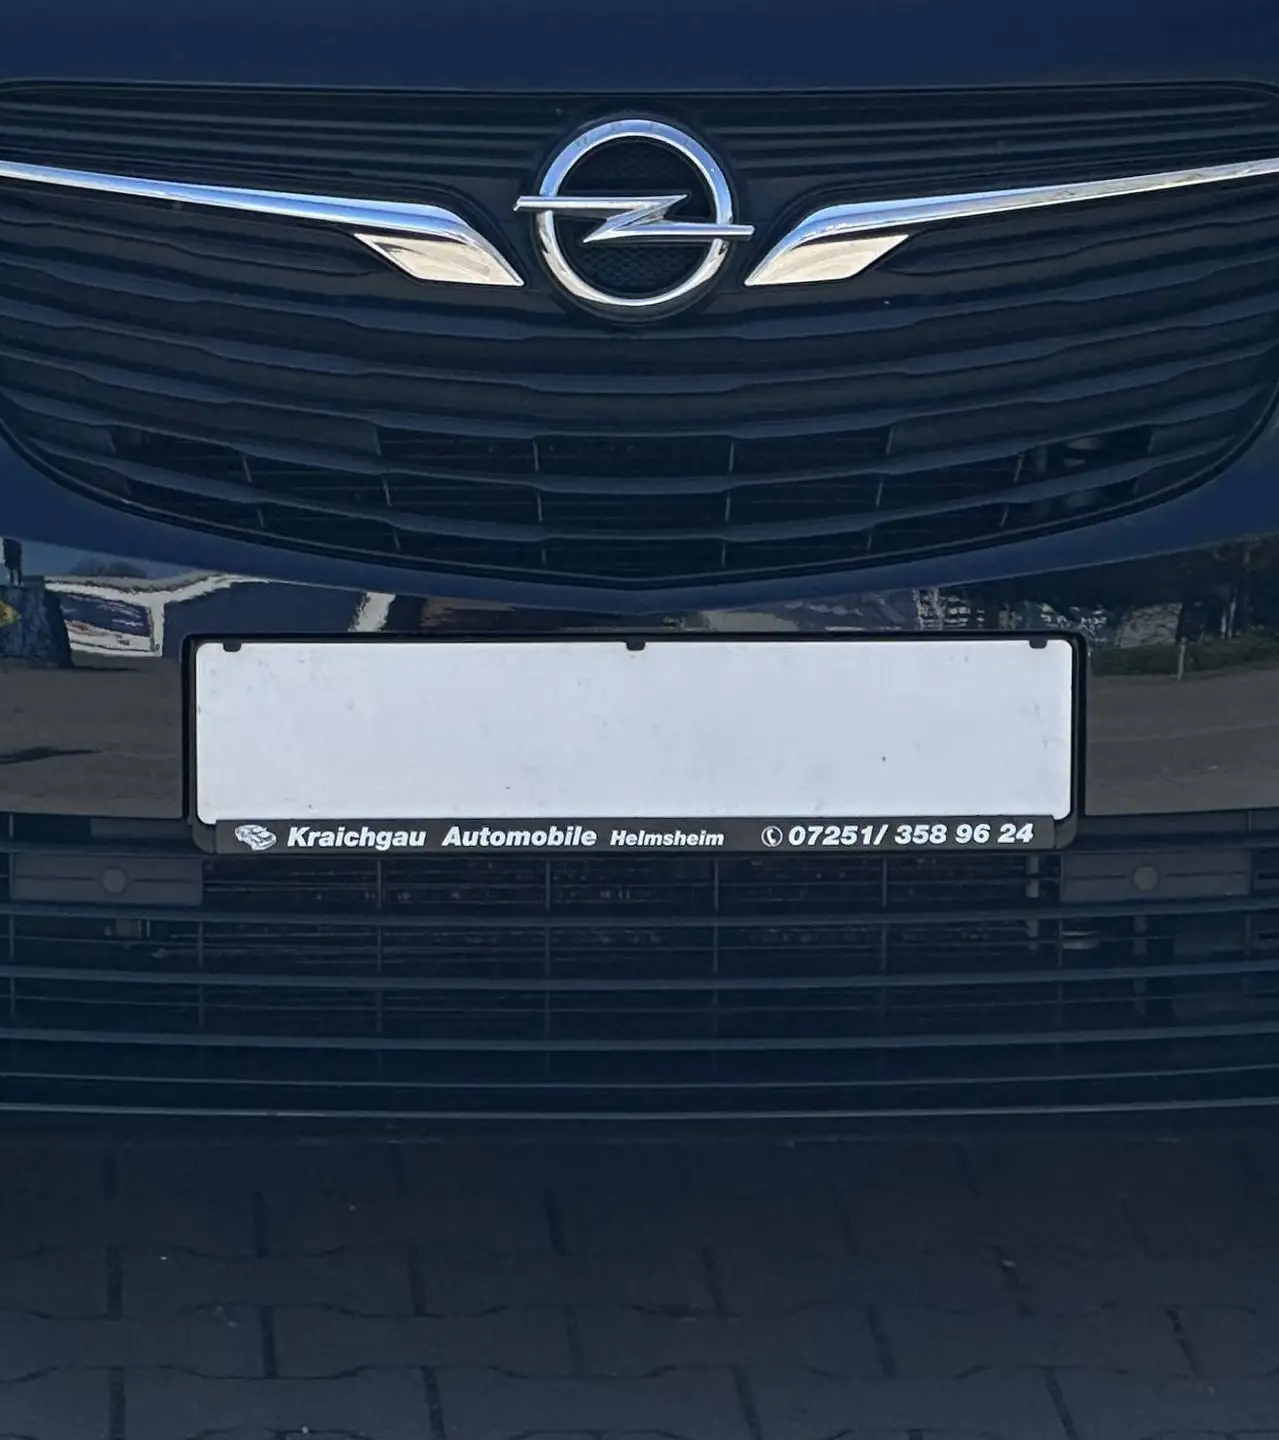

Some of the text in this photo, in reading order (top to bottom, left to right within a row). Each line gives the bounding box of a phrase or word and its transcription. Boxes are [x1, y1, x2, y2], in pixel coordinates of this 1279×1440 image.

[286, 825, 725, 852] Kraichgau Automobile Helmsheim
[787, 822, 1034, 847] 07251/ 358 96 24
